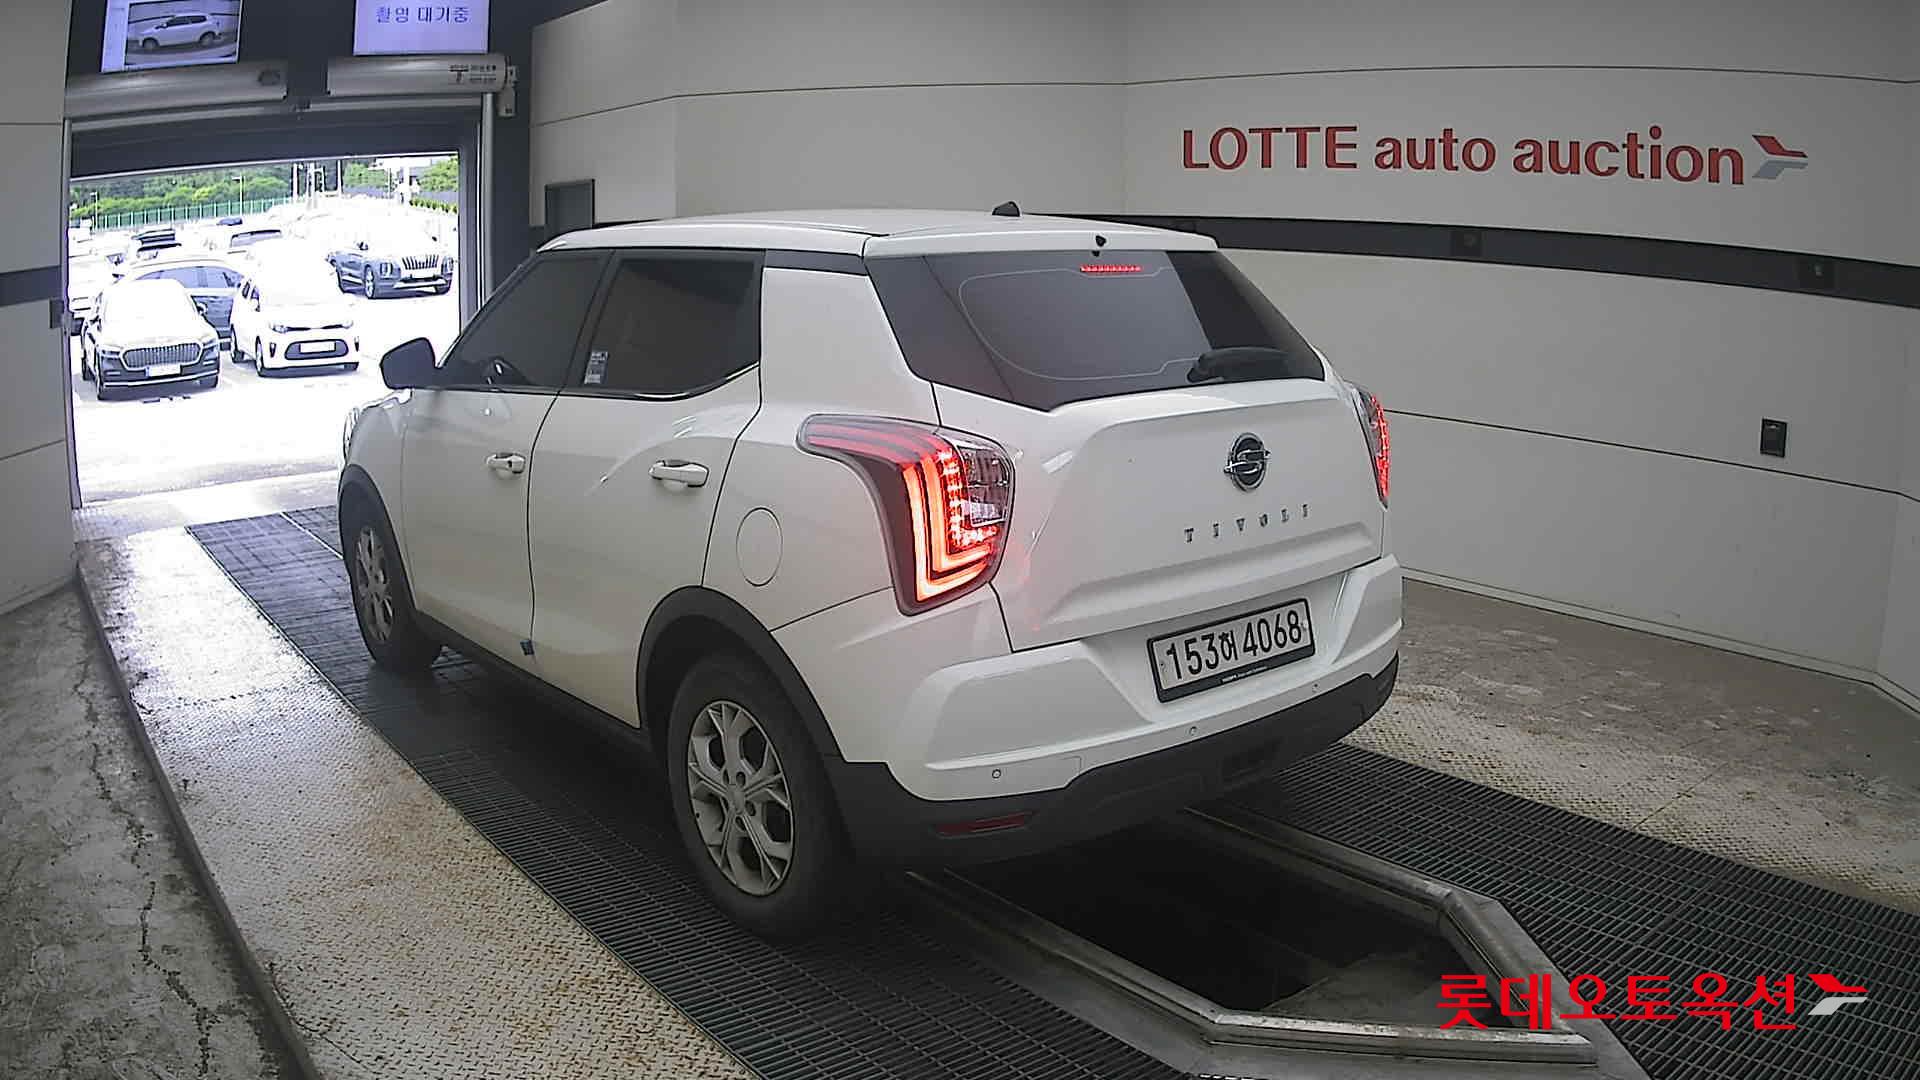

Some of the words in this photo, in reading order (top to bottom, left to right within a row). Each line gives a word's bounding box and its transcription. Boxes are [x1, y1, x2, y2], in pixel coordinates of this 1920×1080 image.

[418, 6, 469, 23] 대기중
[1183, 126, 1358, 169] LOTTE
[1374, 128, 1496, 171] auto
[1513, 125, 1744, 185] auction
[1184, 503, 1310, 543] TIVOLI
